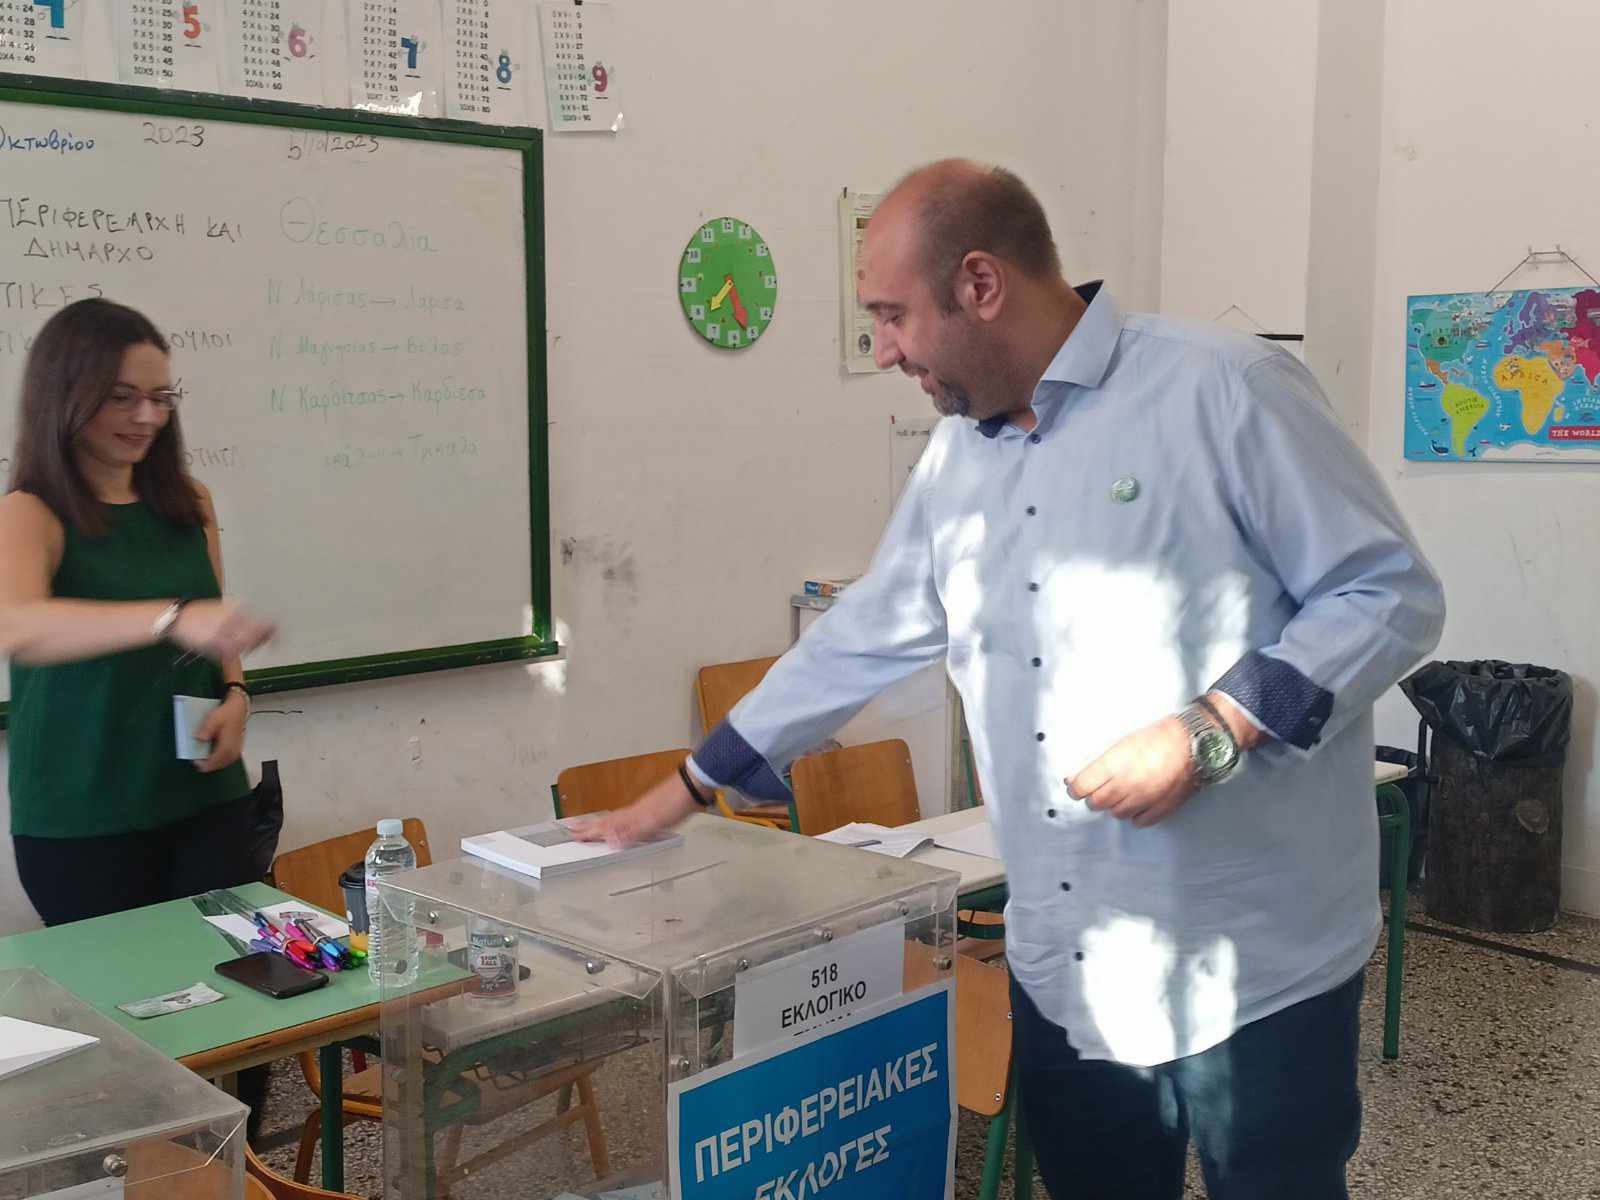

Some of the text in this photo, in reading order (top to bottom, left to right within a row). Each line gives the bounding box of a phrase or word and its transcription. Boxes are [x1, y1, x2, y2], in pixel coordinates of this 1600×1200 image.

[183, 5, 201, 39] 5
[288, 27, 307, 58] 6
[401, 37, 418, 69] 7
[496, 54, 512, 83] 8
[592, 65, 608, 92] 9
[142, 122, 206, 147] 2023
[24, 237, 153, 263] ΔΗΜΑΡΧΟ
[1552, 429, 1569, 437] THE
[811, 963, 838, 989] 518
[781, 980, 867, 1029] ΕΚΛΟΓΙΚΟ
[695, 1042, 938, 1184] ΠΕΡΙΦΕΡΕΙΑΚΕΣ
